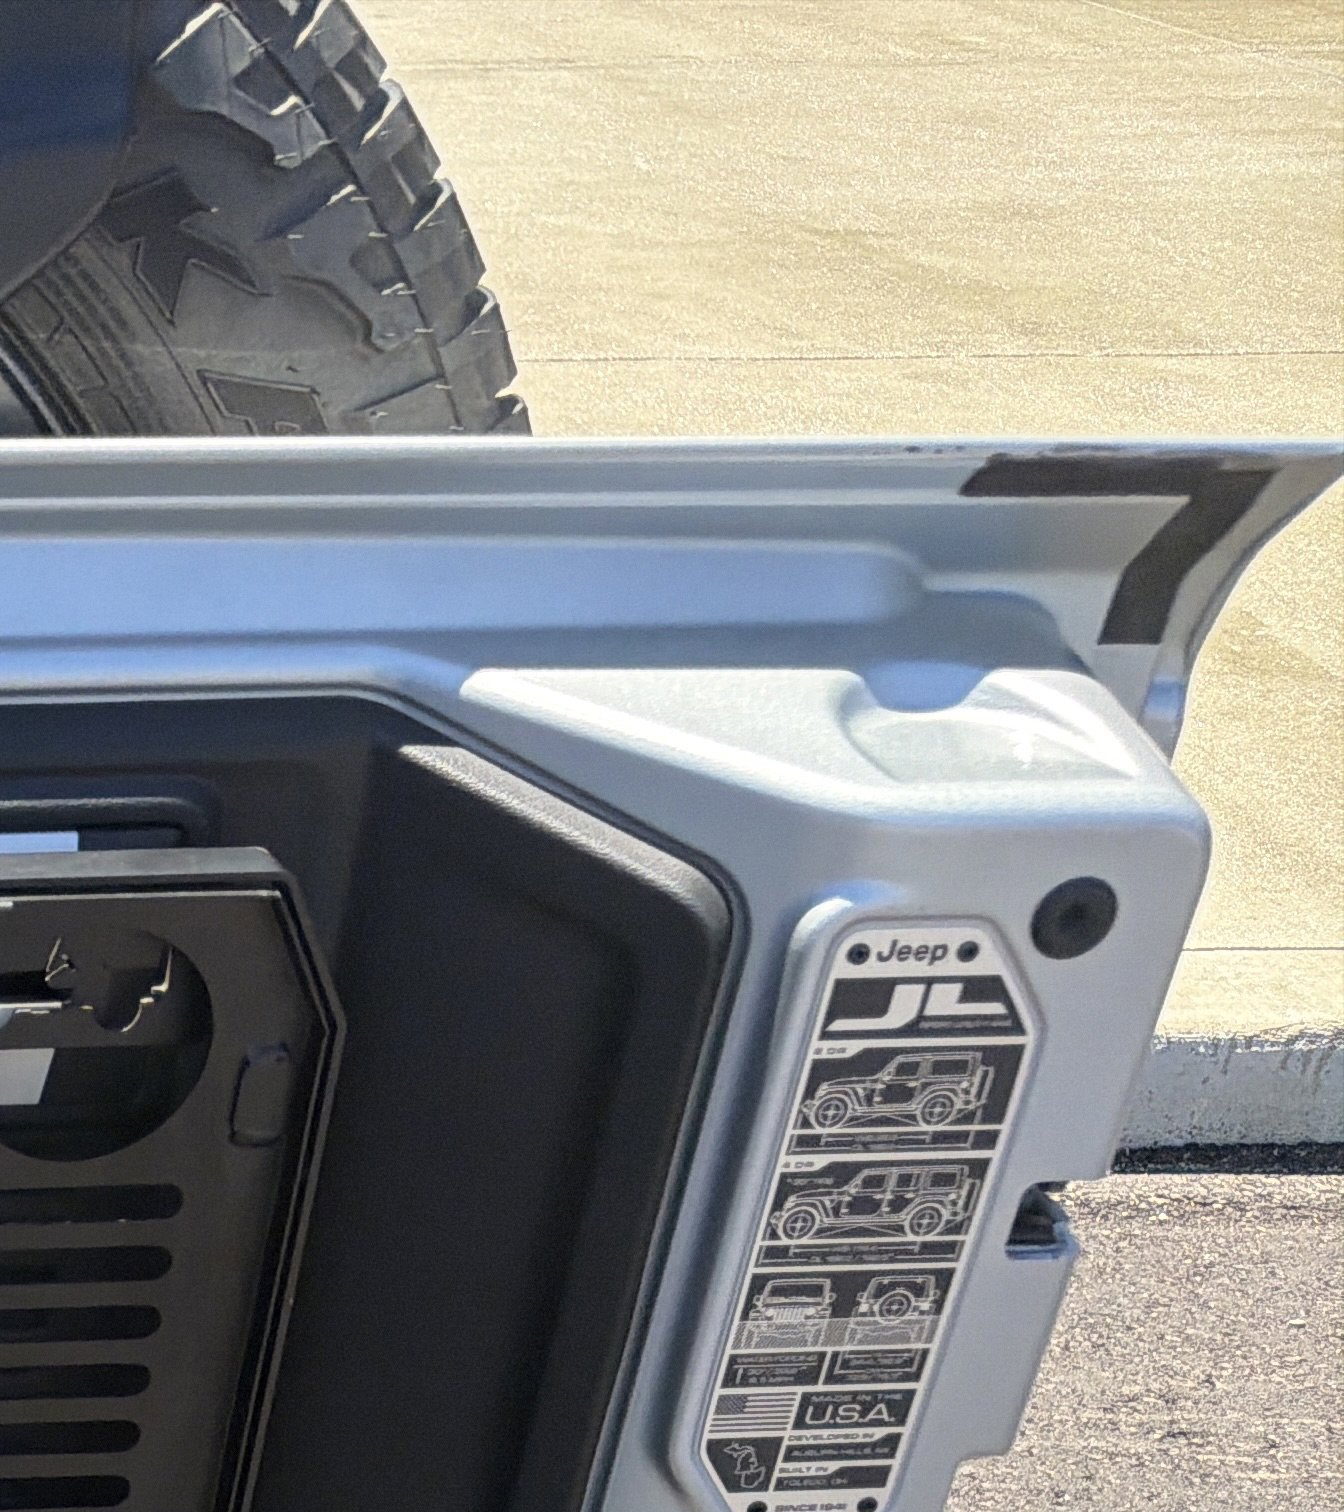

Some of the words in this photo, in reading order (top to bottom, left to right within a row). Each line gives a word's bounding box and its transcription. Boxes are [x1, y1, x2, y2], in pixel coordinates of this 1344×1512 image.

[876, 939, 949, 966] Jeep
[824, 982, 1009, 1032] JL
[804, 1402, 896, 1425] U.S.A.
[775, 1504, 818, 1512] SINCE
